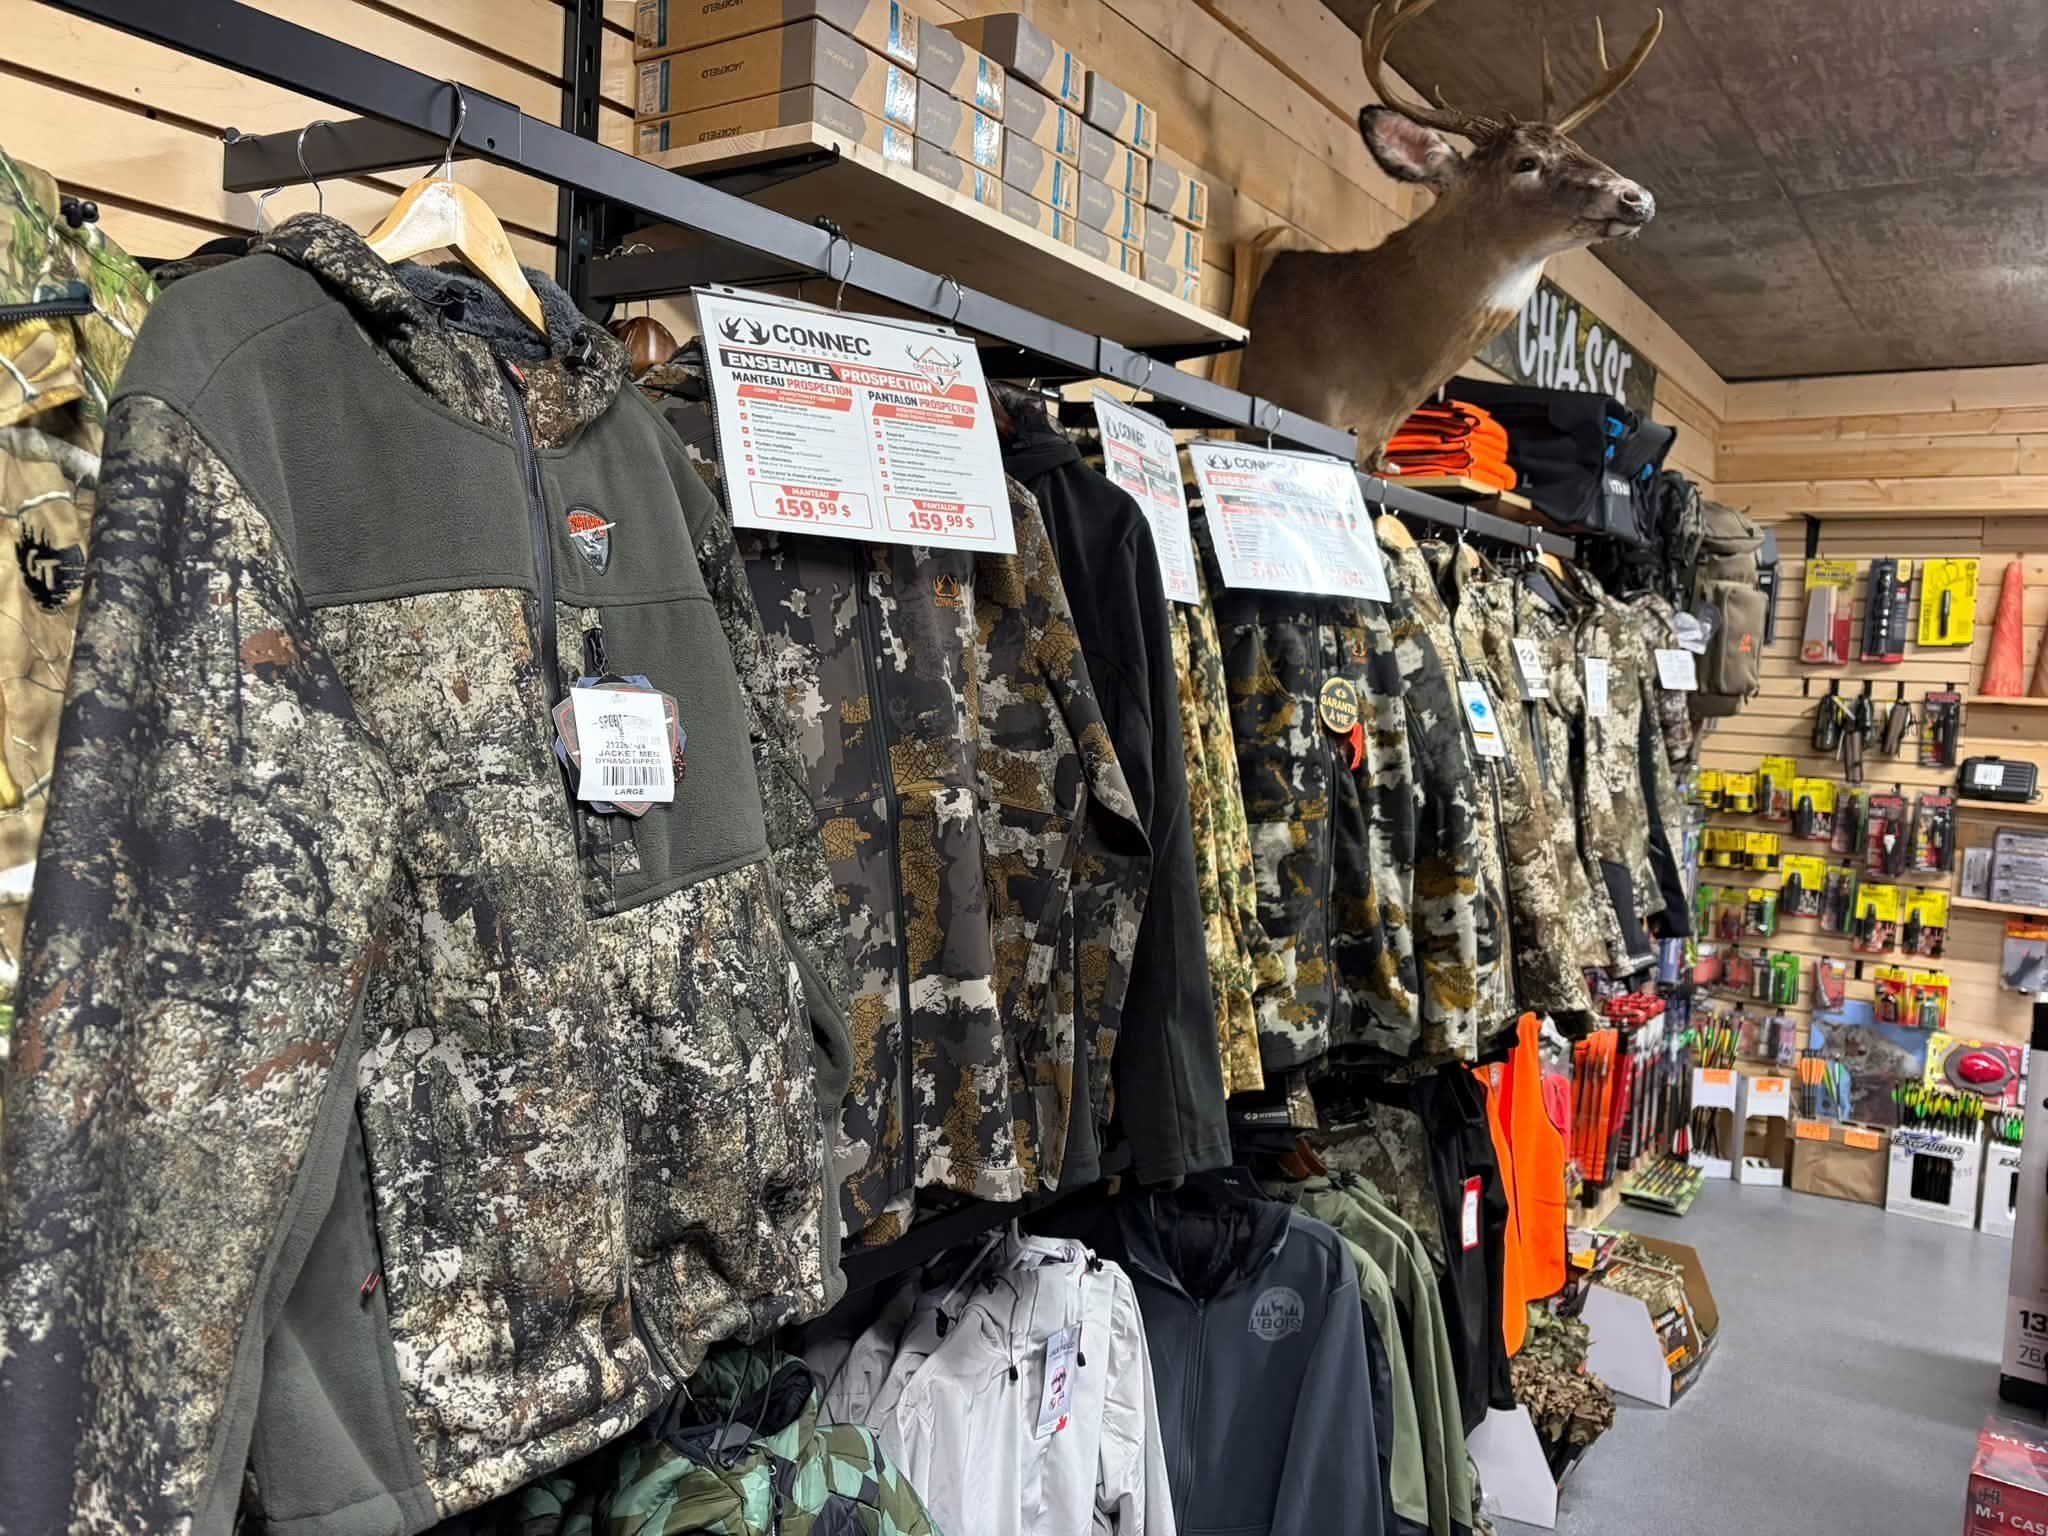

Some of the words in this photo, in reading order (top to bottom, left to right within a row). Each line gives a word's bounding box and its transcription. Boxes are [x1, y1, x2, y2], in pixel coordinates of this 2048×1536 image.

[701, 61, 744, 79] JACKFIELD
[772, 324, 872, 356] CONNEC
[1518, 289, 1632, 406] CHASSE
[727, 353, 832, 379] ENSEMBLE
[841, 368, 934, 393] PROSPECTION
[732, 372, 785, 387] MANTEAU
[786, 378, 853, 397] PROSPECTION
[868, 391, 918, 407] PANTALON
[919, 398, 976, 415] PROSPECTION
[791, 488, 830, 499] MANTEAU
[775, 497, 838, 521] 159,99
[841, 505, 851, 518] $
[908, 511, 963, 534] 159,99
[966, 515, 975, 529] $
[599, 750, 636, 758] JACKET
[614, 788, 645, 797] LARGE
[1976, 1503, 2005, 1523] M-1
